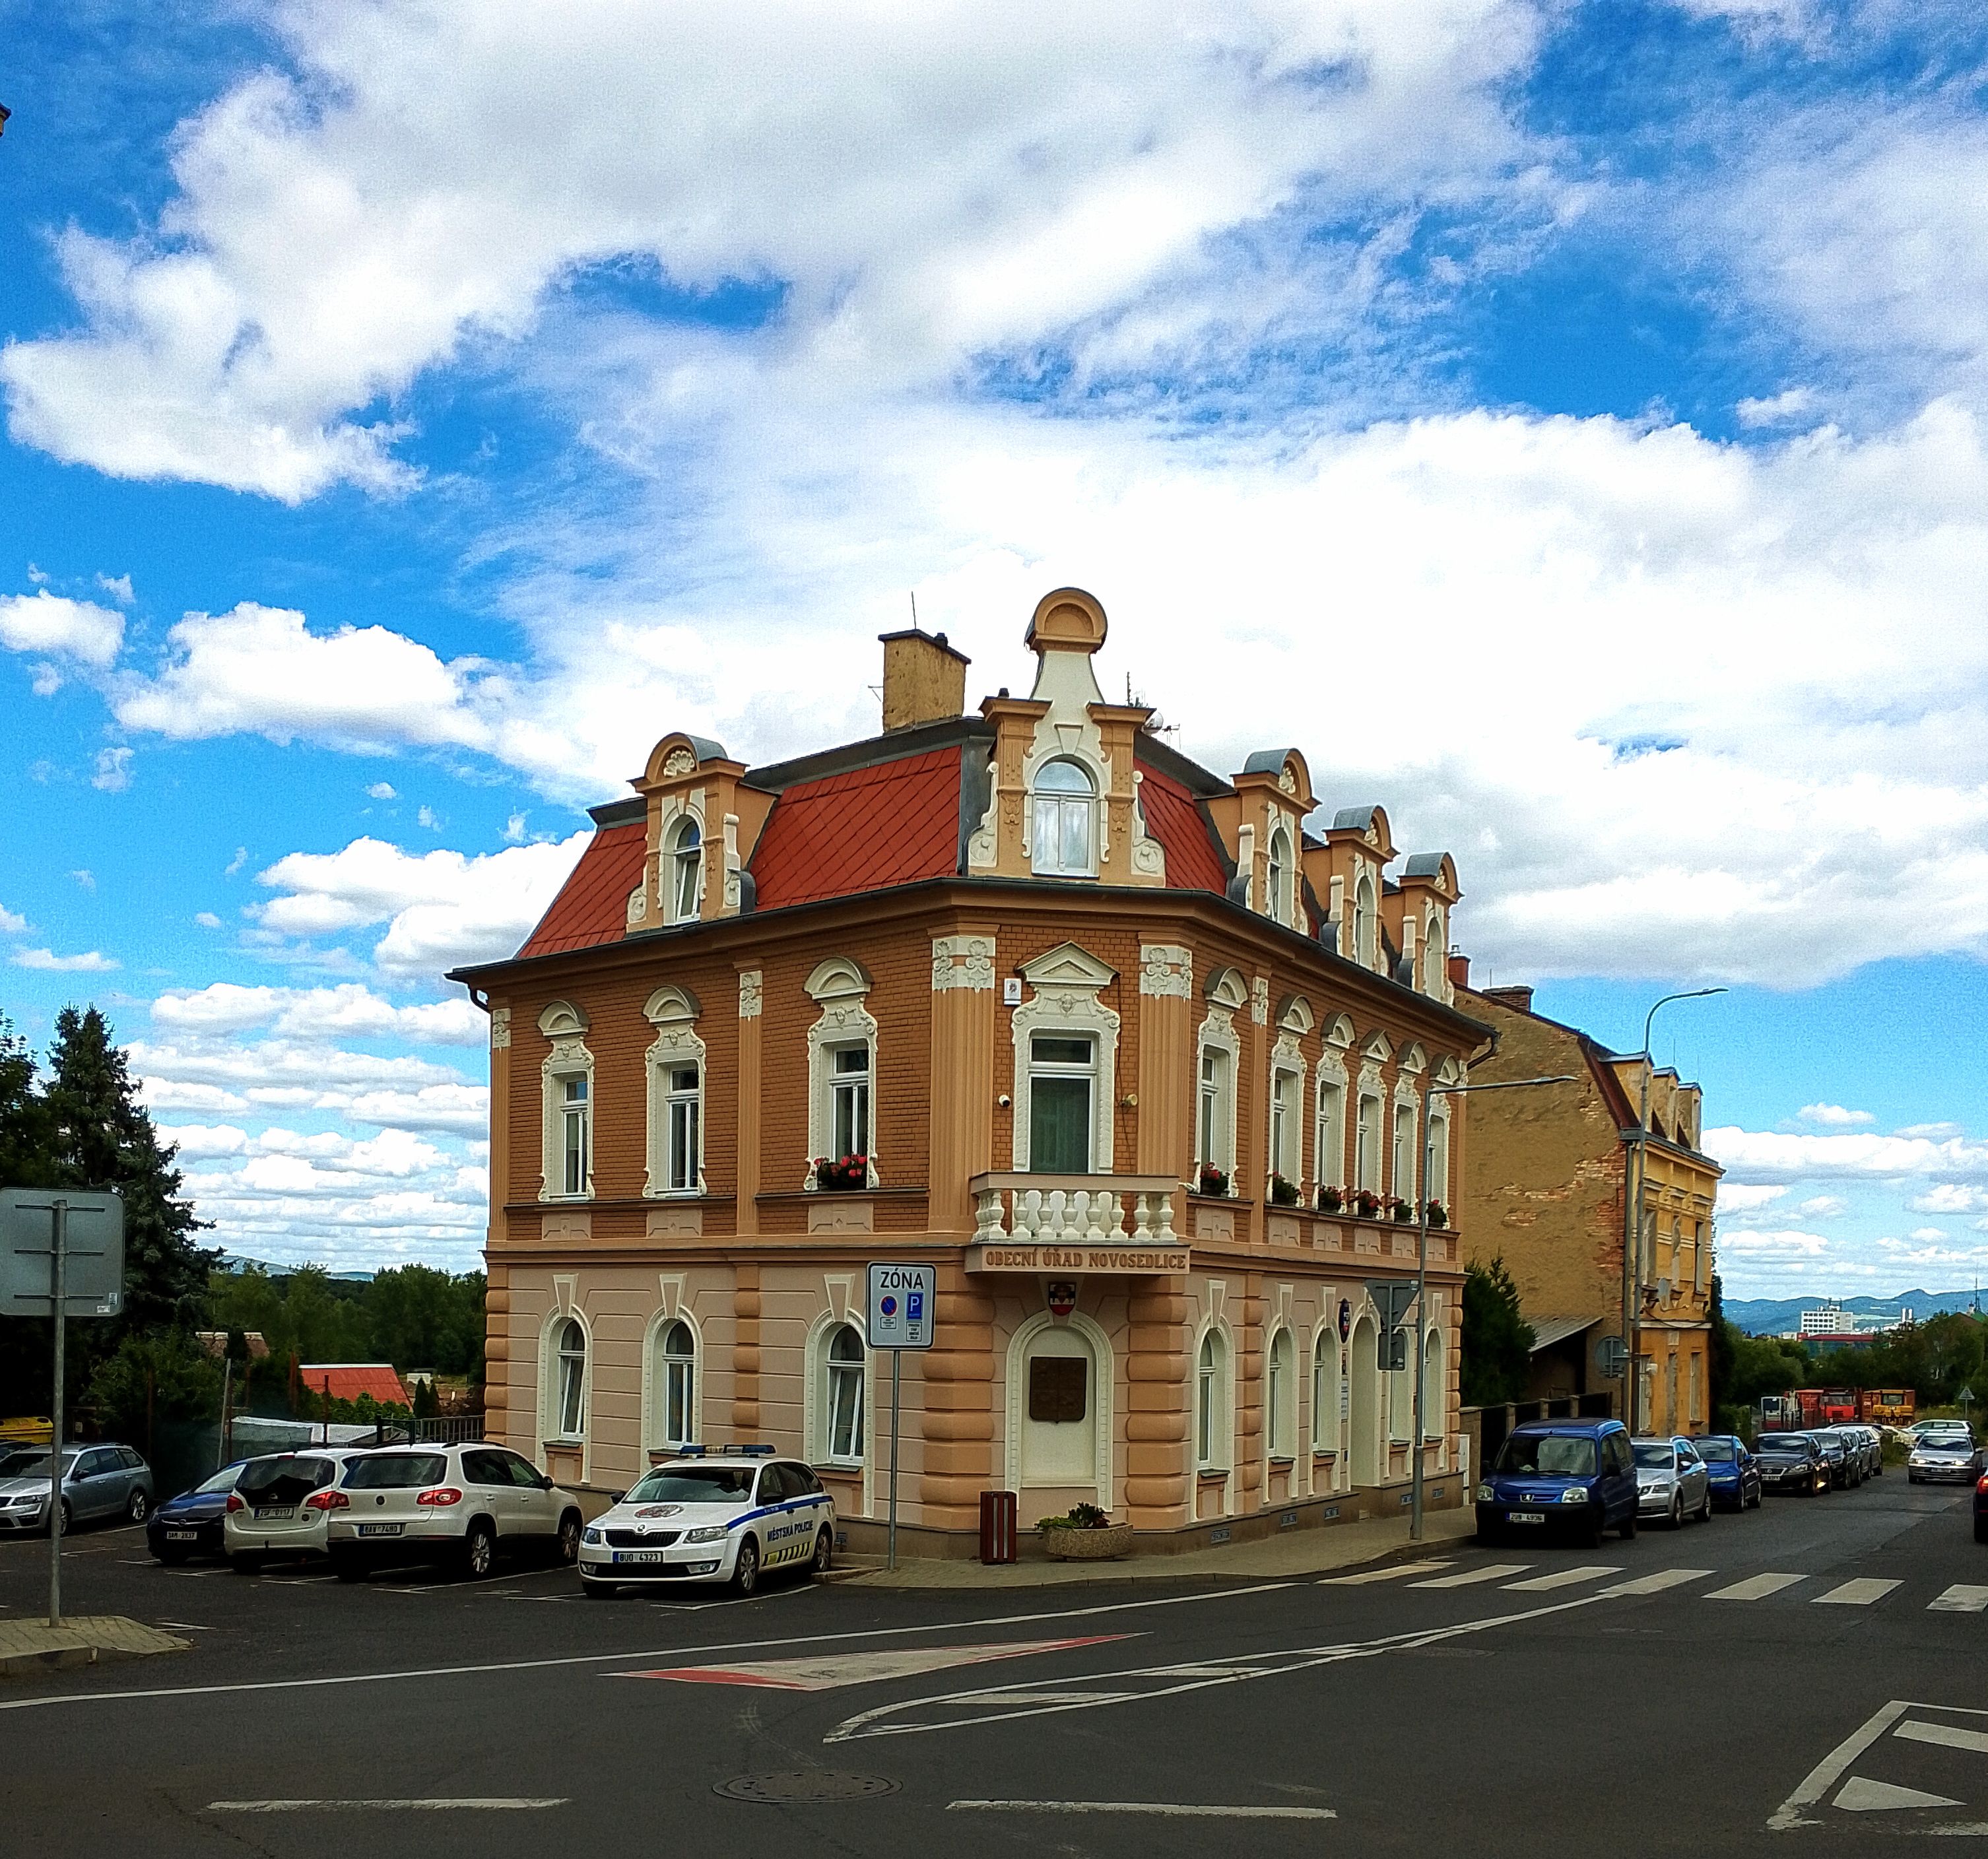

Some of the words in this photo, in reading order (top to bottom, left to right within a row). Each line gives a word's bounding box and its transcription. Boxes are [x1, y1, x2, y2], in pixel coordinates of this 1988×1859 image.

[986, 1247, 1038, 1266] OBECNÍ
[1042, 1247, 1083, 1266] ÚŘAD
[1088, 1251, 1186, 1269] NOVOSEDLICE
[880, 1267, 924, 1289] ZÓNA
[910, 1295, 919, 1312] P
[639, 1553, 659, 1562] 4323
